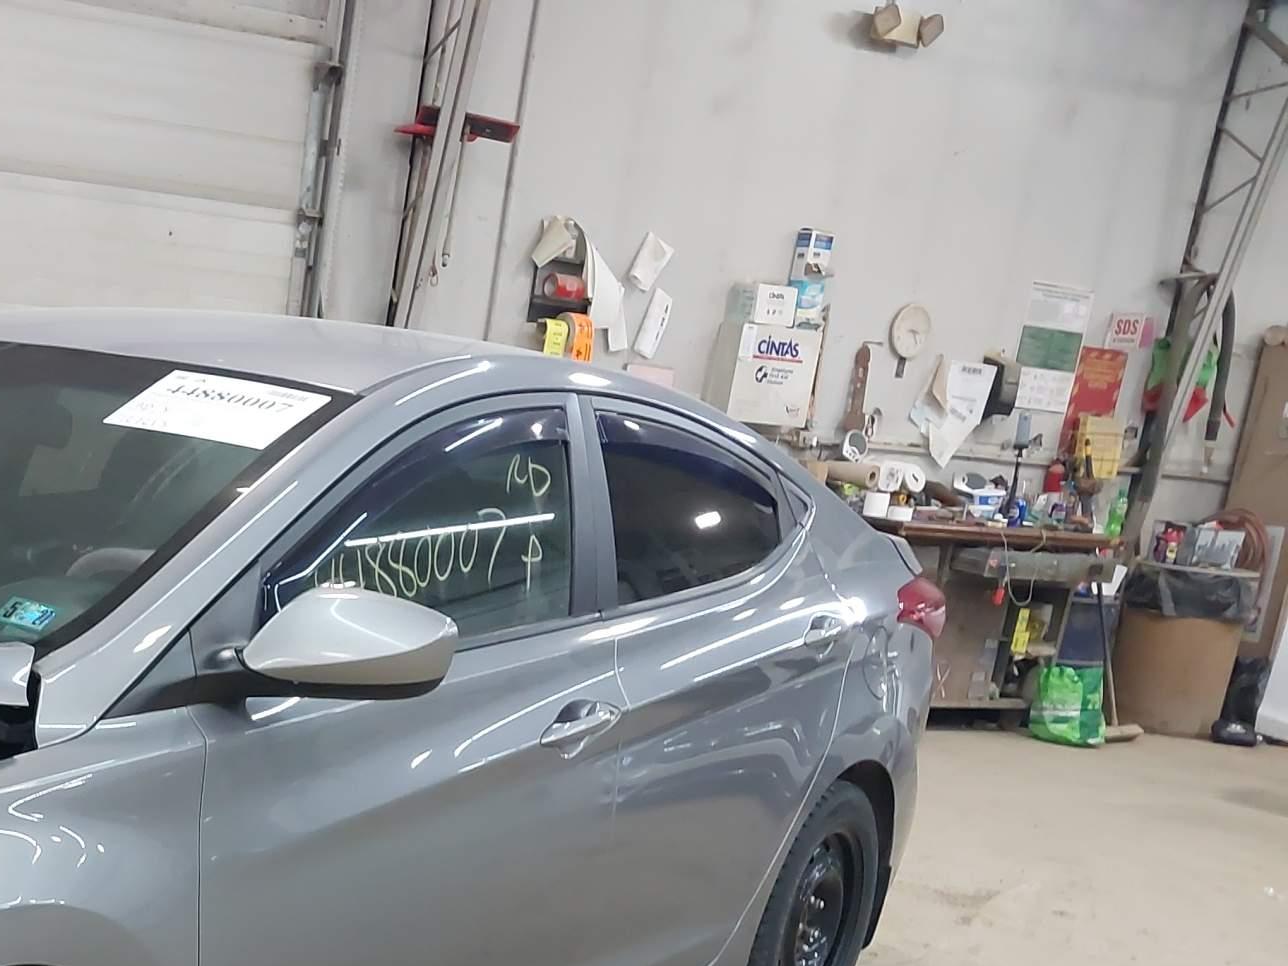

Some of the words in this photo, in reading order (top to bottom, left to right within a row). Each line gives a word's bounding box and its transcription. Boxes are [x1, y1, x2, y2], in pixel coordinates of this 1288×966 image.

[1114, 319, 1139, 336] SDS
[757, 335, 800, 358] CINTAS
[167, 384, 294, 414] 44880007
[2, 601, 23, 618] 5
